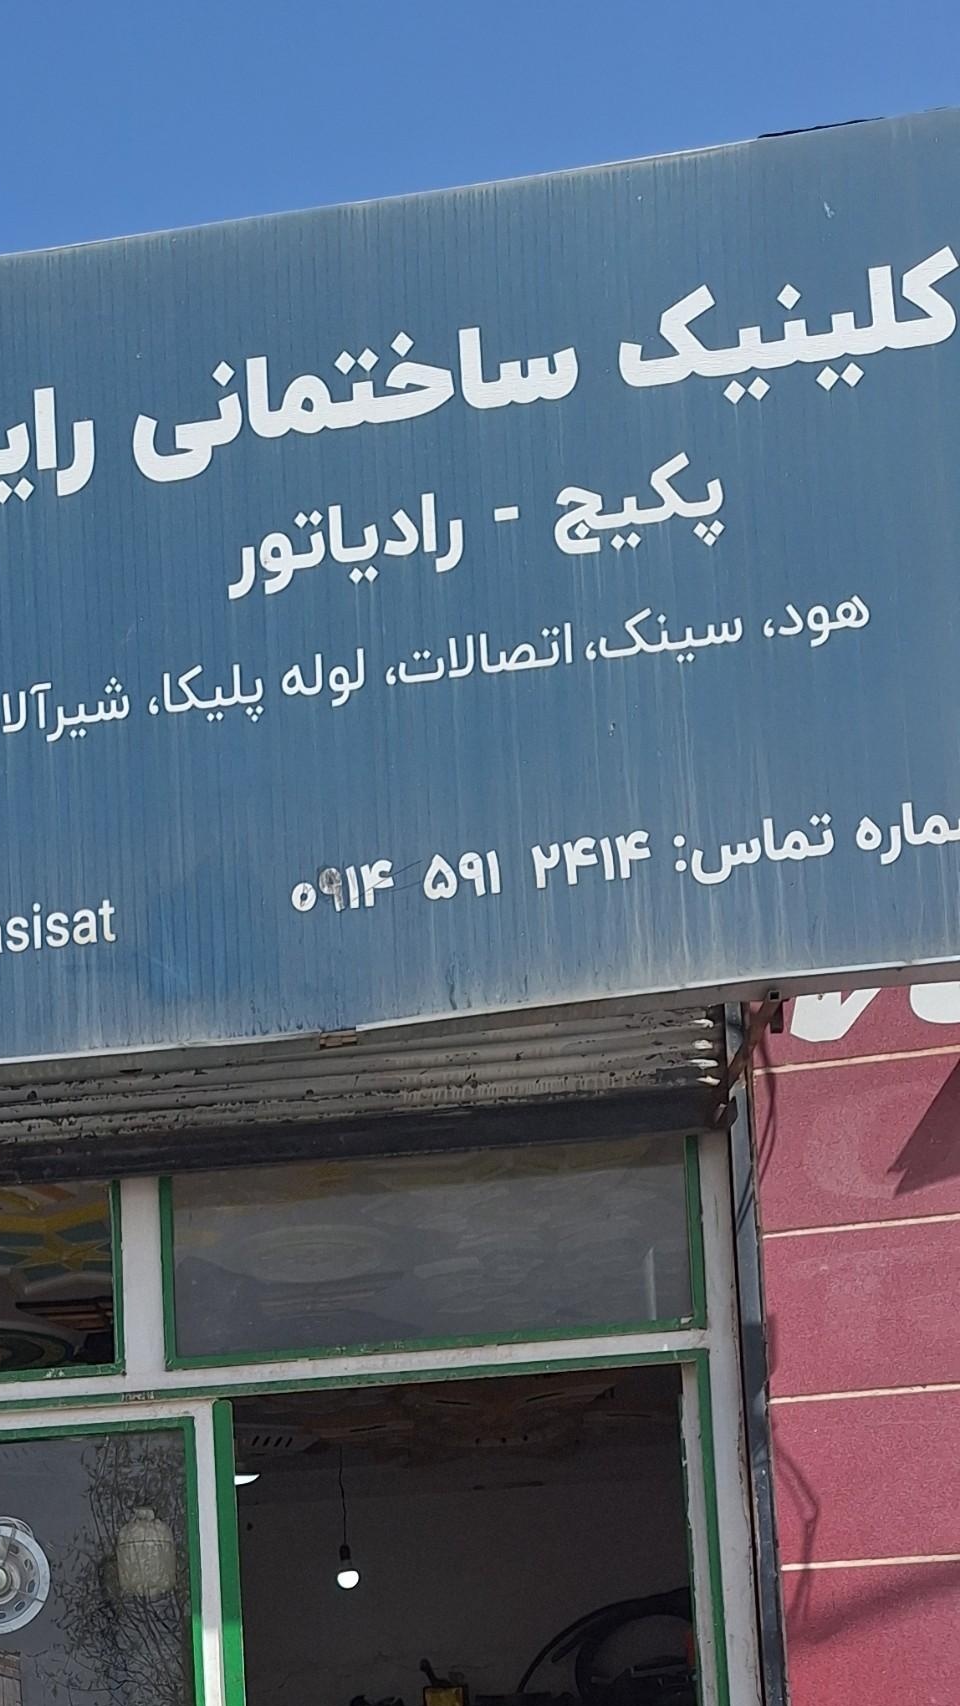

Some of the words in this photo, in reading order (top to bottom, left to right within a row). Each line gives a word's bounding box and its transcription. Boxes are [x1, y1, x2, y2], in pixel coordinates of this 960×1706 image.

[619, 245, 959, 405] کلینیک
[132, 326, 579, 483] ساختمانی
[227, 492, 464, 600] رادیاتور
[554, 451, 725, 555] پکیج
[281, 647, 365, 708] لوله
[855, 801, 960, 865] ماره
